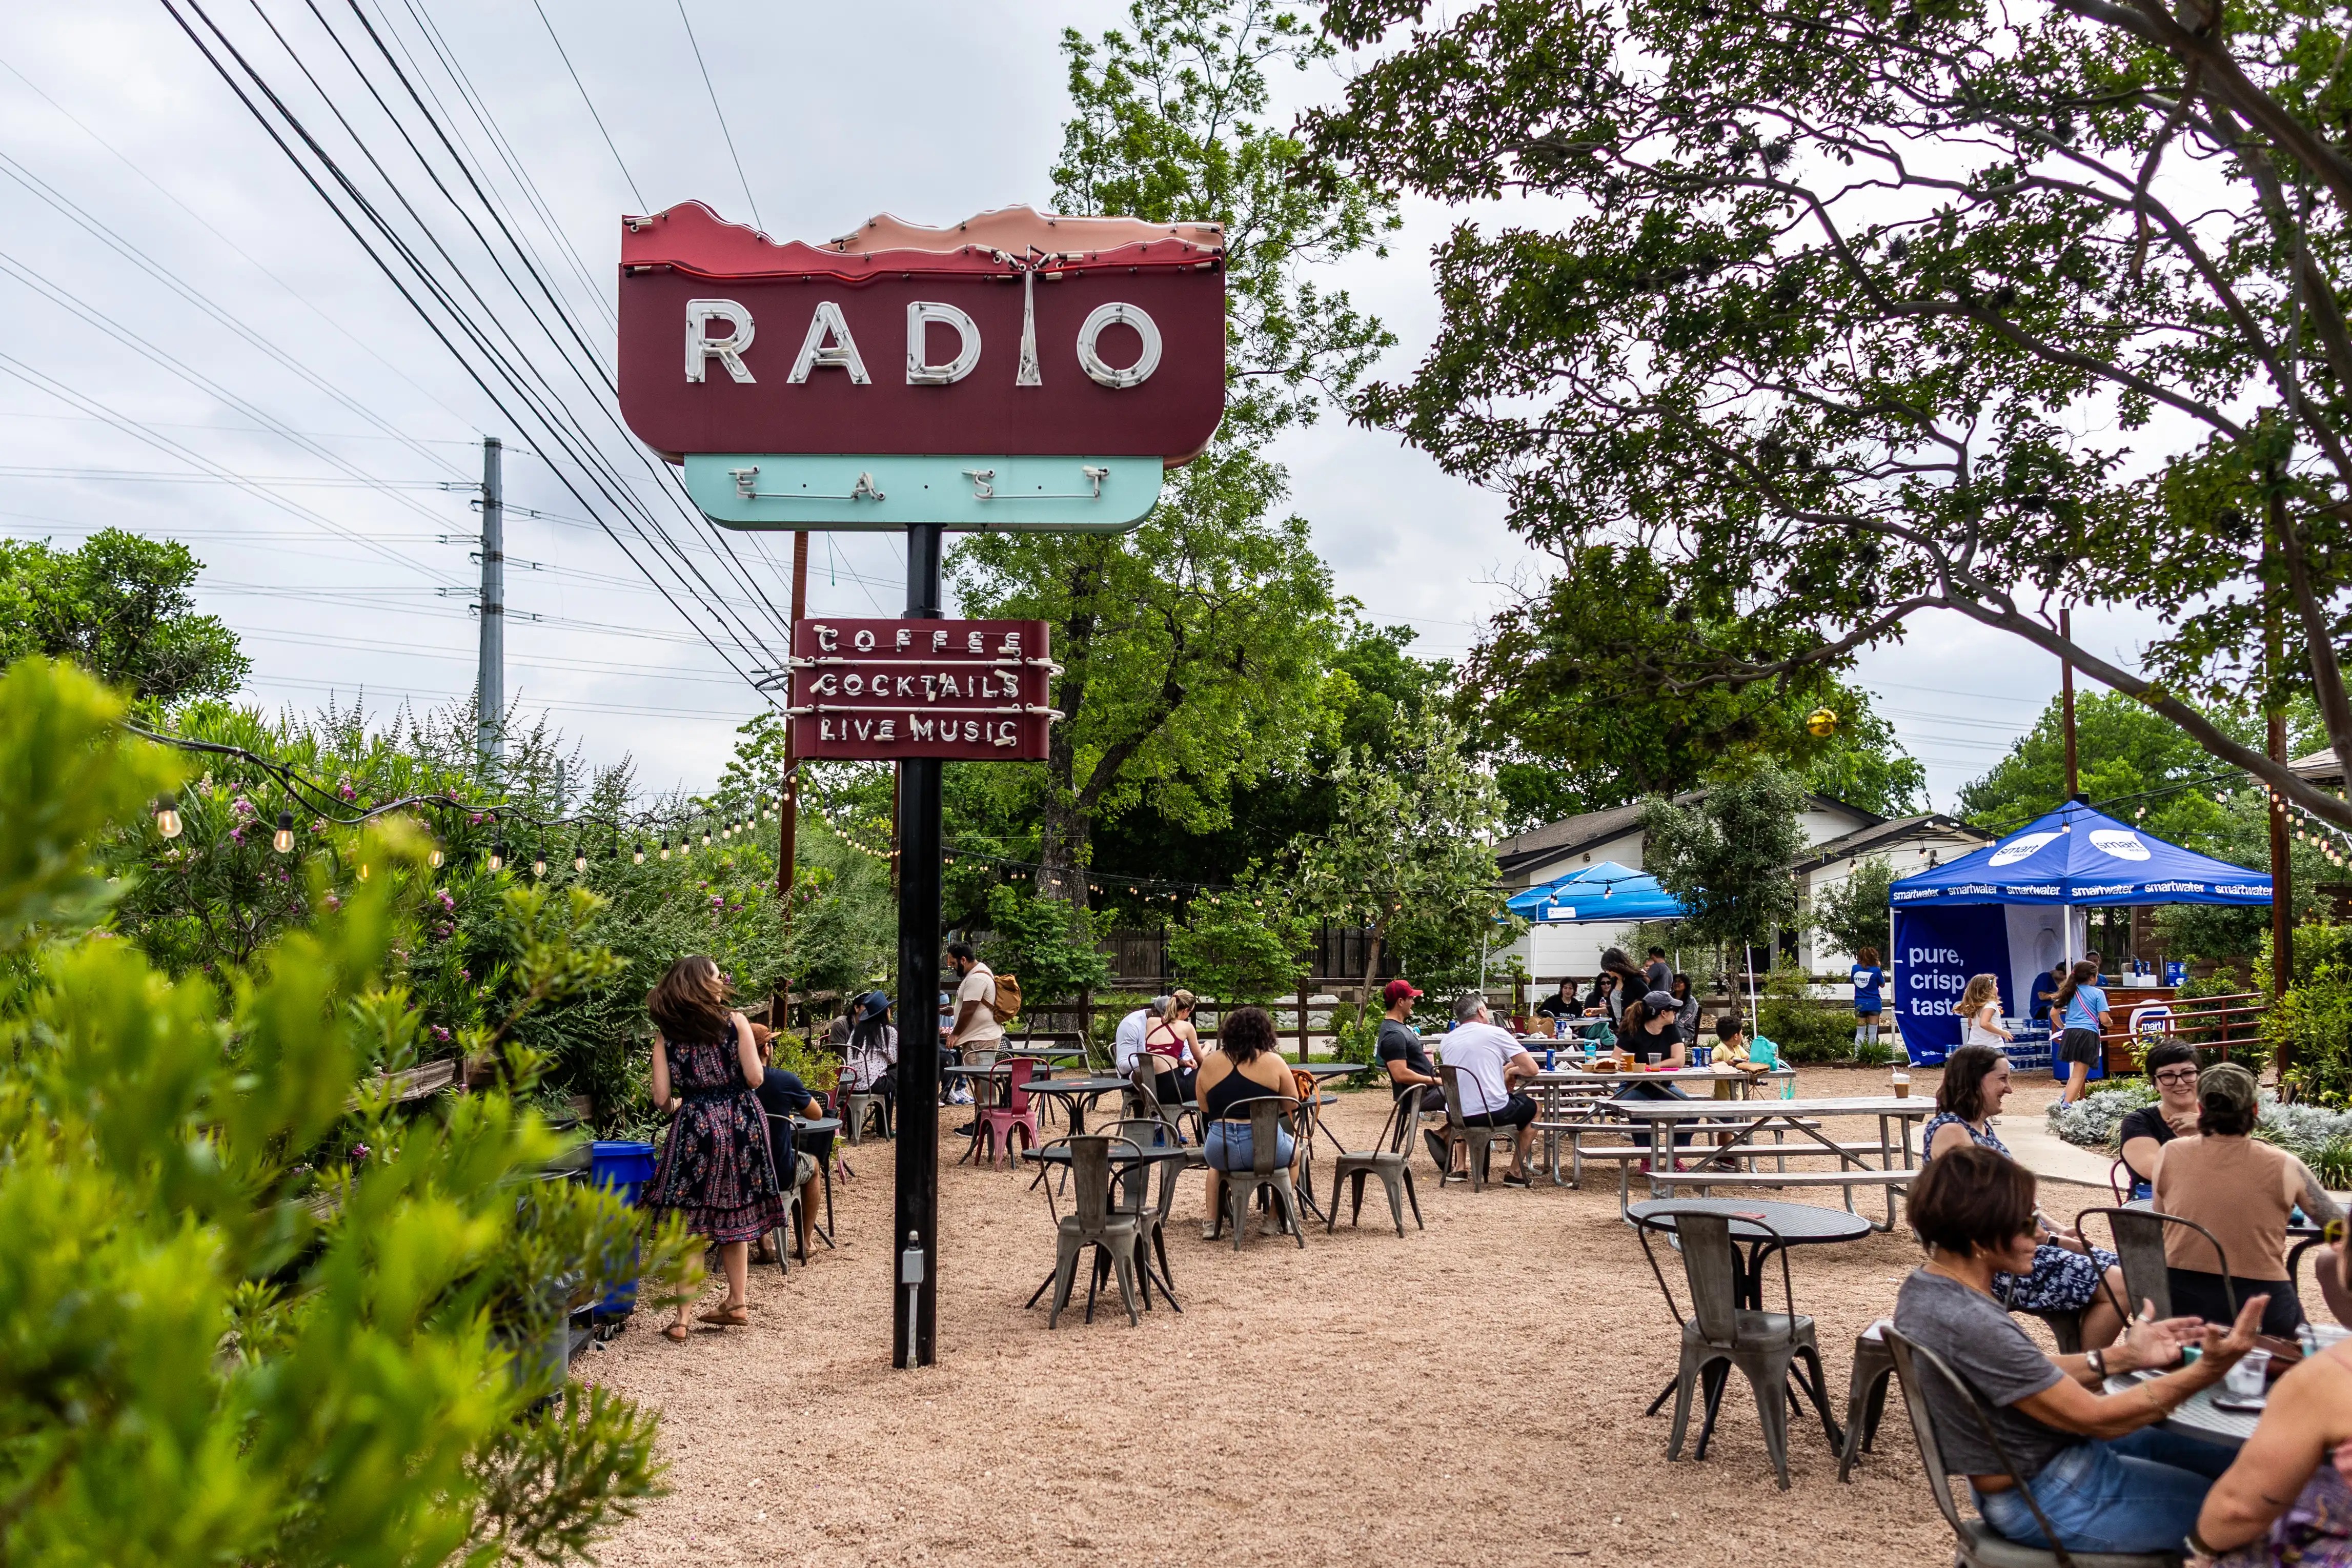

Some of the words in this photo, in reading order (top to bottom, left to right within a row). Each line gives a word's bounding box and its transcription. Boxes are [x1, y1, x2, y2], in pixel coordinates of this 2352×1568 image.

[685, 271, 1163, 389] RADIO
[727, 465, 1110, 501] EAST
[818, 628, 1021, 655] COFFEE
[818, 671, 1019, 699] COCKTAILS
[820, 718, 897, 741] LIVE
[911, 718, 1017, 743] MUSIC
[1997, 844, 2039, 856] smart
[2096, 840, 2143, 849] smart
[1948, 884, 1997, 895] smartwater
[2006, 884, 2061, 895] smartwater
[2071, 884, 2134, 897] smartwater
[2144, 881, 2204, 893] smartwater
[1893, 888, 1939, 900] smartwater
[1909, 948, 1964, 967] pure,
[1910, 969, 1965, 994] crisp
[2141, 1021, 2162, 1032] mart
